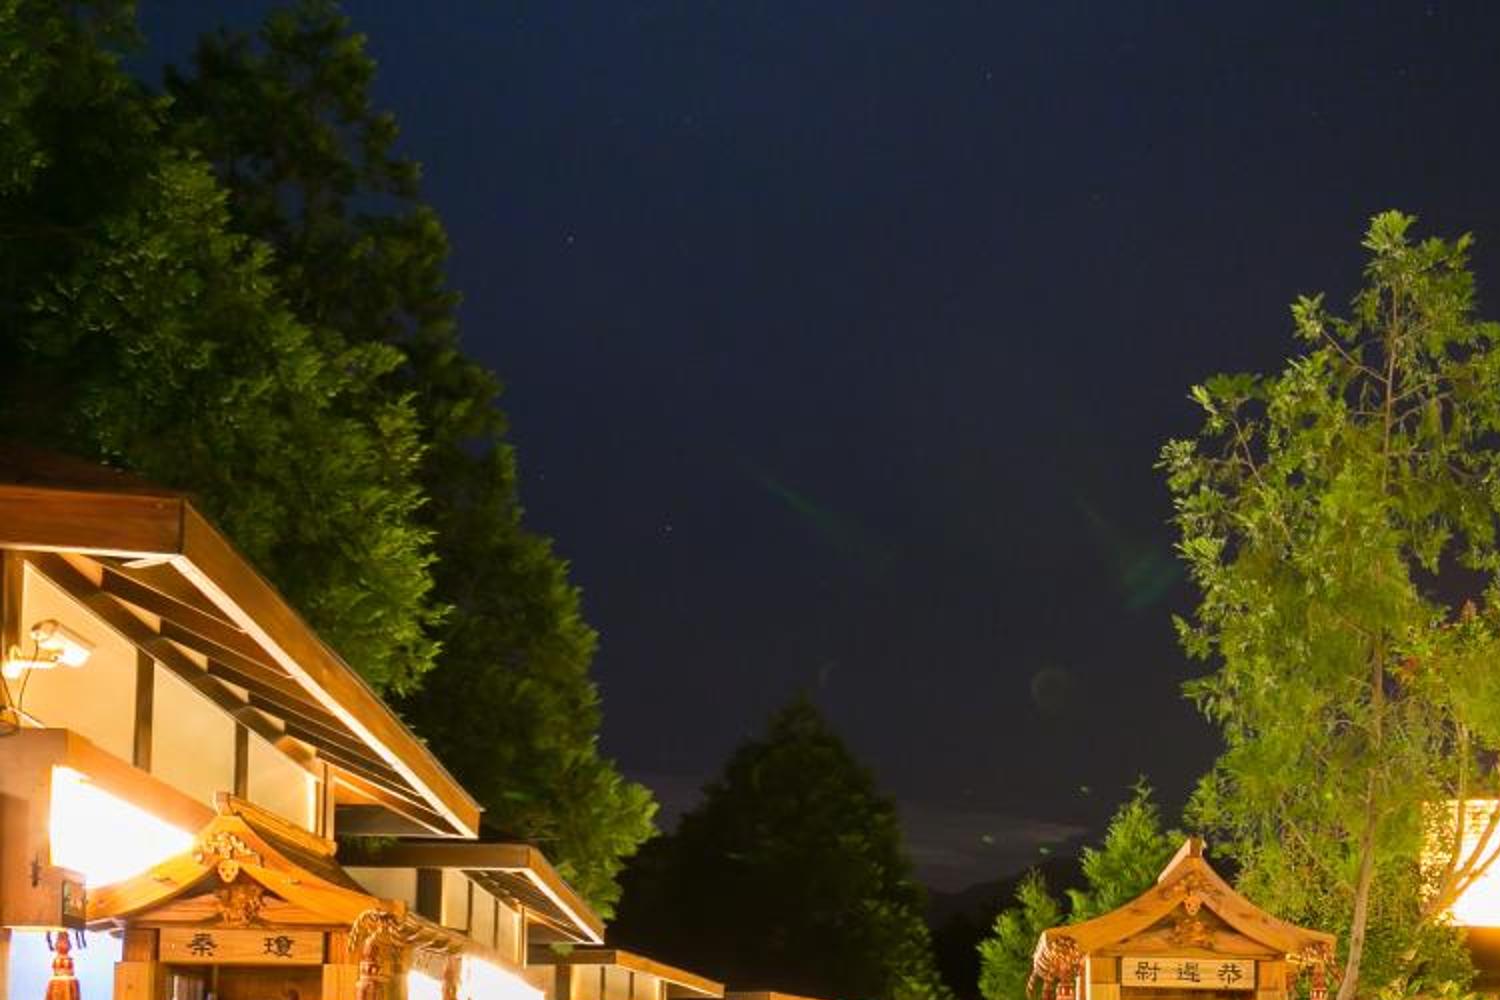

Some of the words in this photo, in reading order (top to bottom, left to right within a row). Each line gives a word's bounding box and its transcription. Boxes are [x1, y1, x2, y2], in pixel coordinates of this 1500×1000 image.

[186, 933, 295, 957] 秦瓊
[1136, 961, 1242, 984] 尉遲恭
